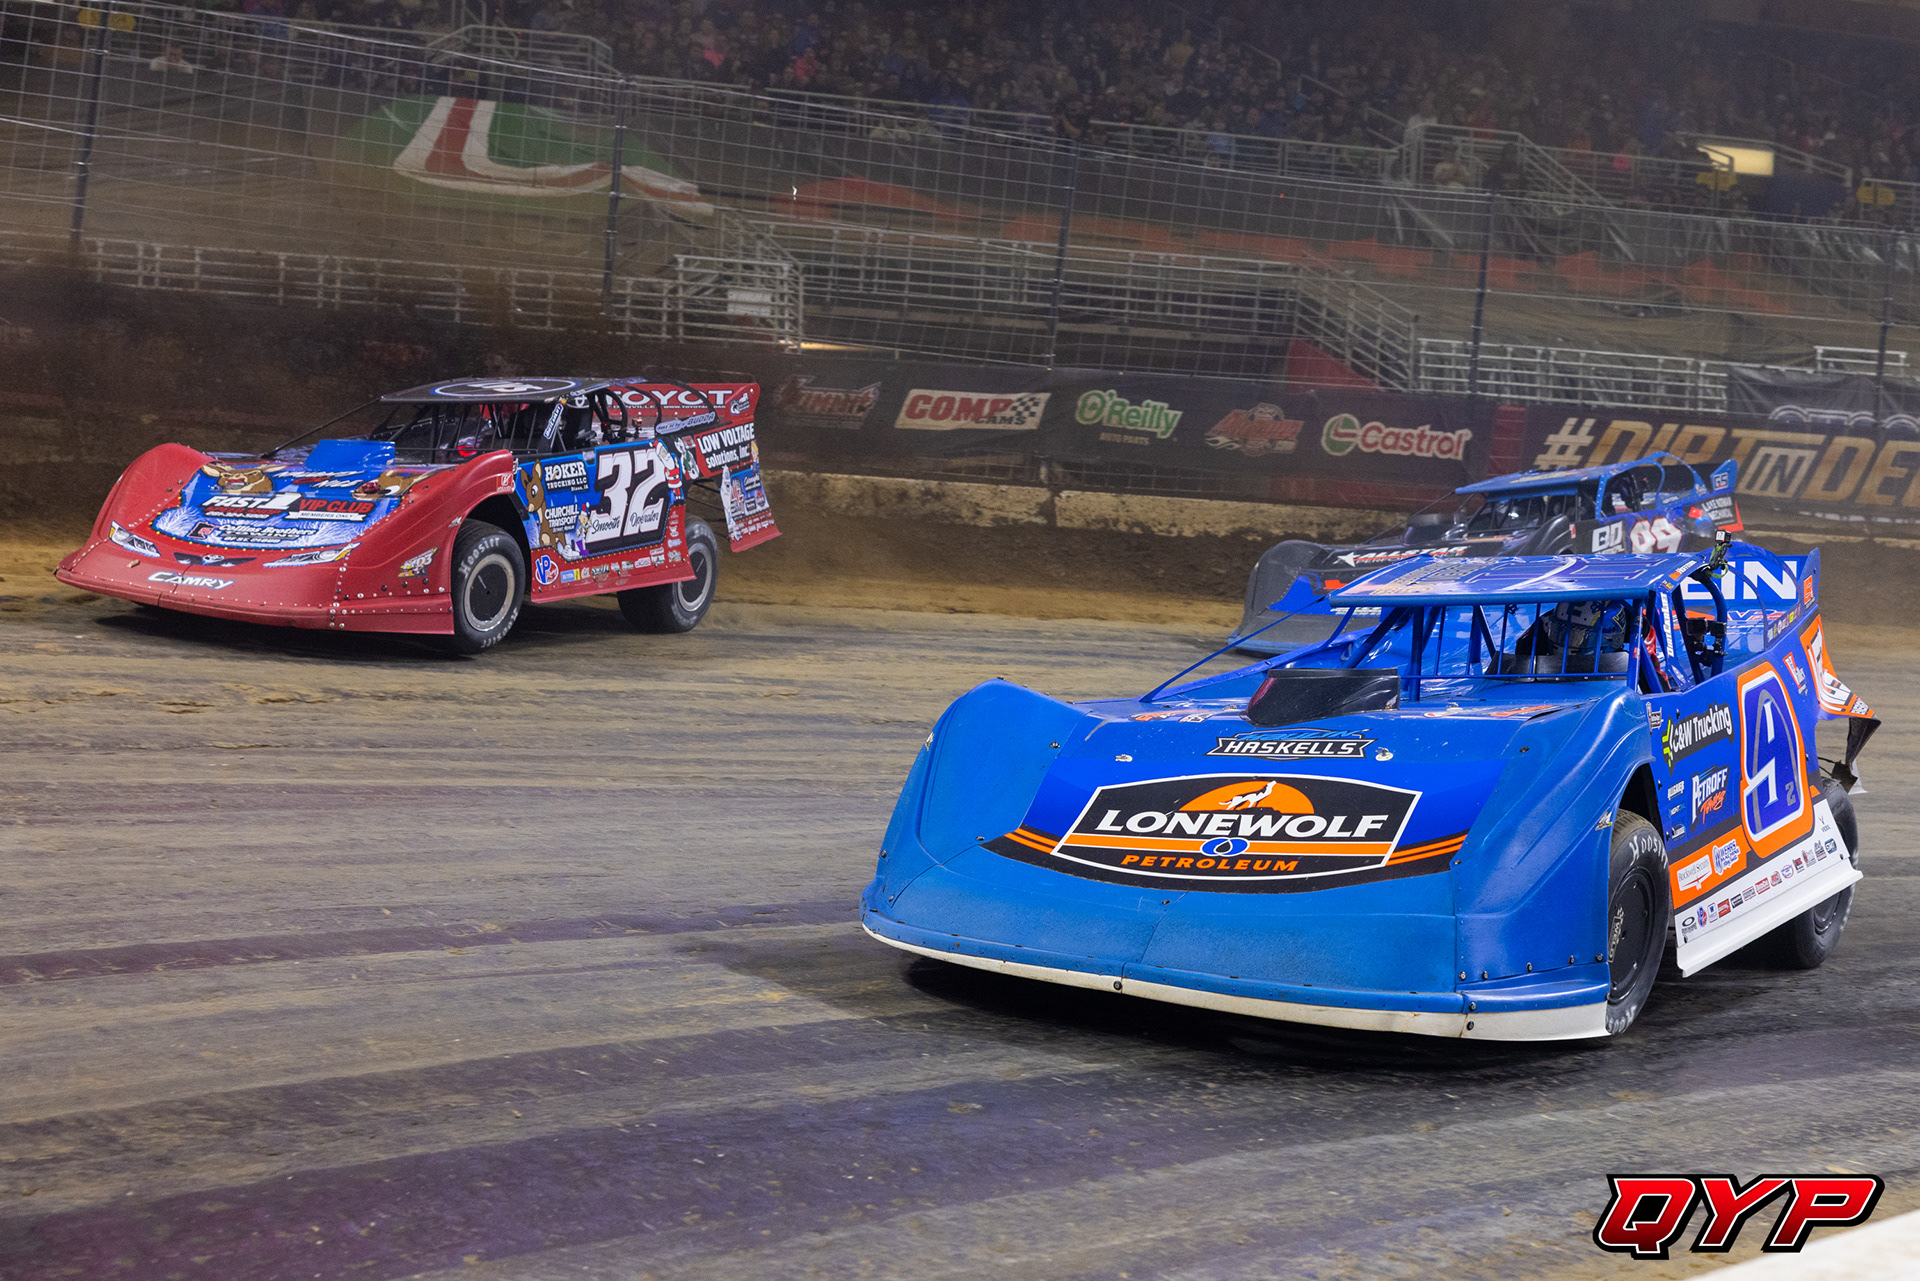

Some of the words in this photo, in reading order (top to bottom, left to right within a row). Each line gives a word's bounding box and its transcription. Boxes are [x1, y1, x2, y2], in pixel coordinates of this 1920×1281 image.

[906, 395, 1012, 422] COMP
[1080, 391, 1180, 437] O'Reilly
[977, 415, 1027, 426] CAMS
[697, 432, 721, 454] LOW
[718, 422, 755, 448] VOLTAGE
[1360, 424, 1468, 457] Castrol
[705, 449, 740, 469] solutions,
[544, 461, 587, 481] HOKER
[547, 479, 575, 489] TRUCKING
[575, 477, 588, 485] LLC
[585, 448, 667, 544] 32
[299, 499, 328, 511] VIP
[326, 500, 374, 514] CLUB
[544, 503, 580, 520] CHURCHILL
[219, 523, 261, 533] Collins
[260, 526, 318, 536] Brothers
[548, 514, 577, 528] TRANSPORT
[536, 556, 552, 584] VP
[148, 571, 237, 591] CAMRY
[1692, 704, 1733, 742] Trucking
[1224, 741, 1357, 755] HASKELLS
[1691, 767, 1729, 824] PETROFF
[1785, 782, 1796, 807] 2
[1094, 810, 1389, 839] LONEWOLF
[1120, 854, 1299, 872] PETROLEUM
